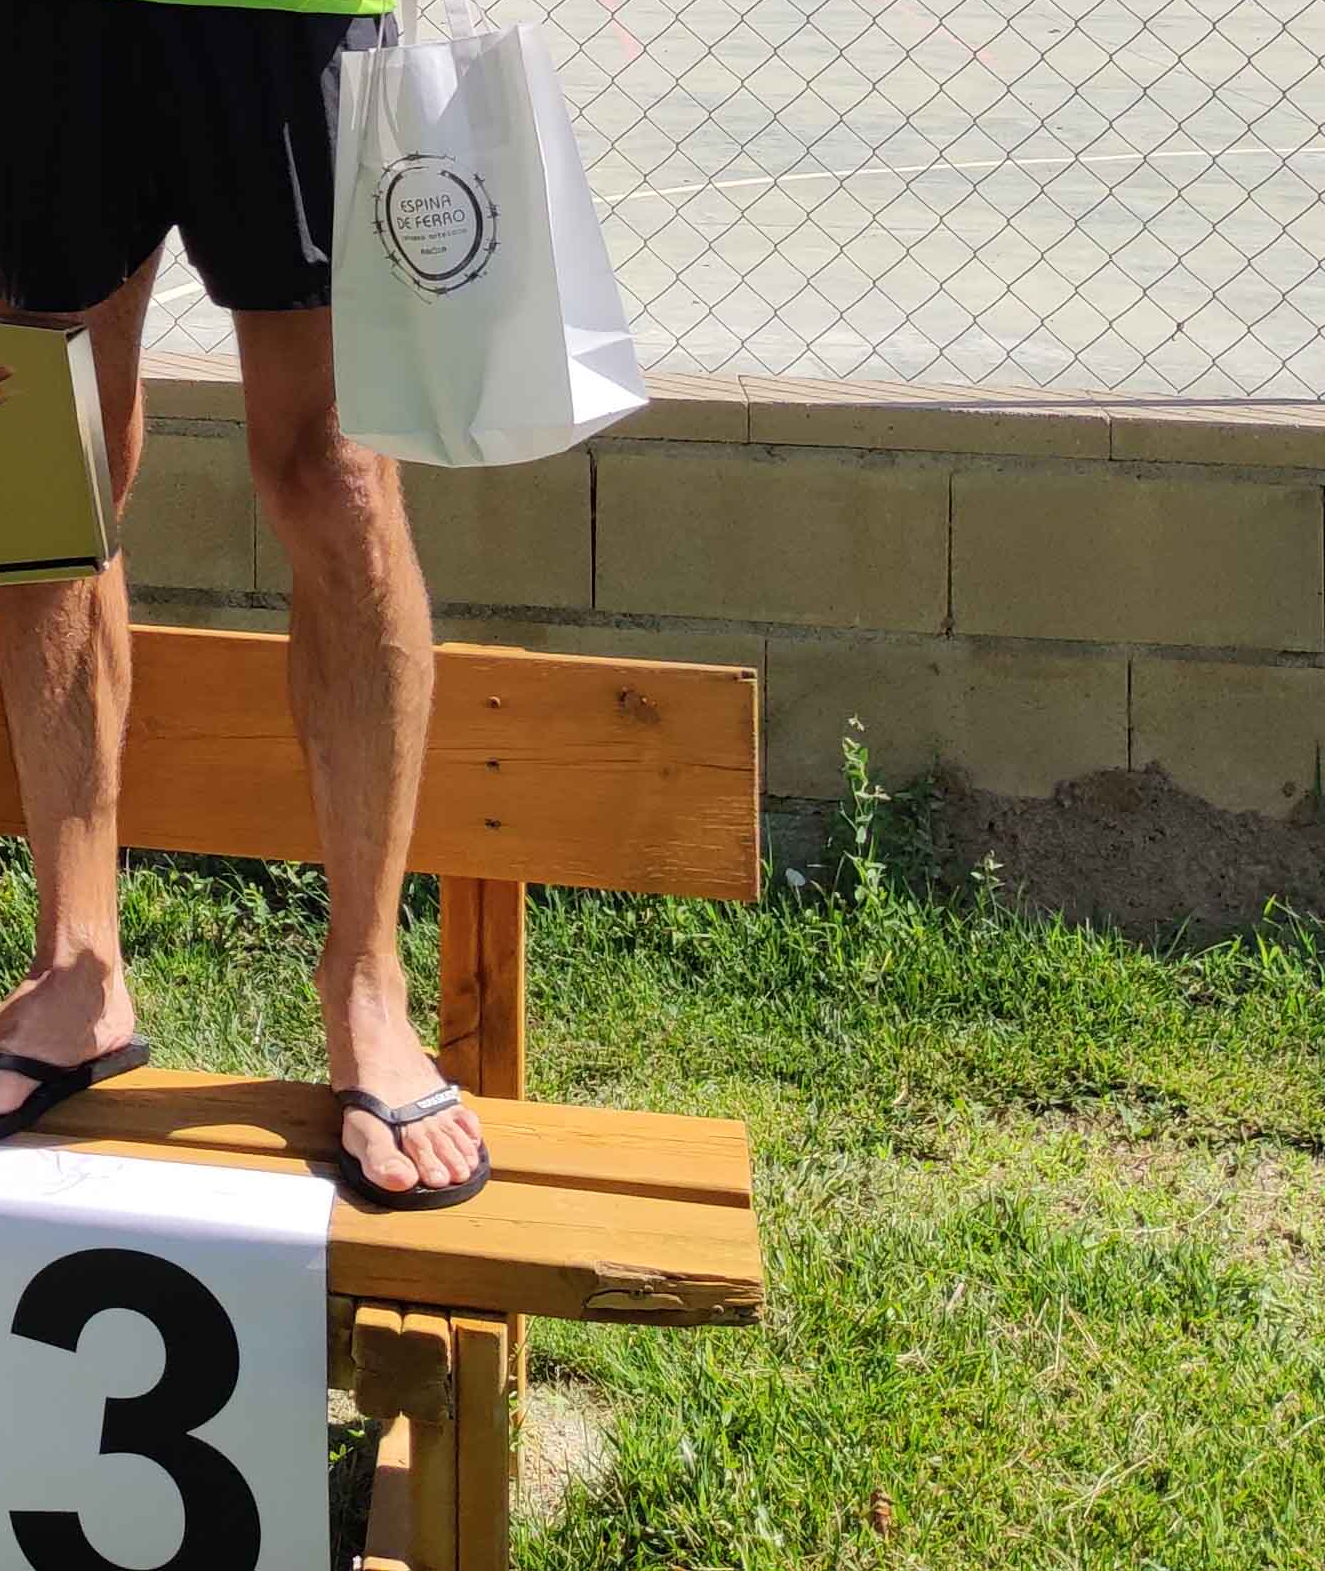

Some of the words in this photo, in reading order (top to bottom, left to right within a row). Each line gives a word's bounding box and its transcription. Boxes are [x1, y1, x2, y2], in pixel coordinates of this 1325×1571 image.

[400, 194, 452, 213] ESPINA
[396, 216, 413, 230] DE
[8, 1246, 263, 1571] 3
